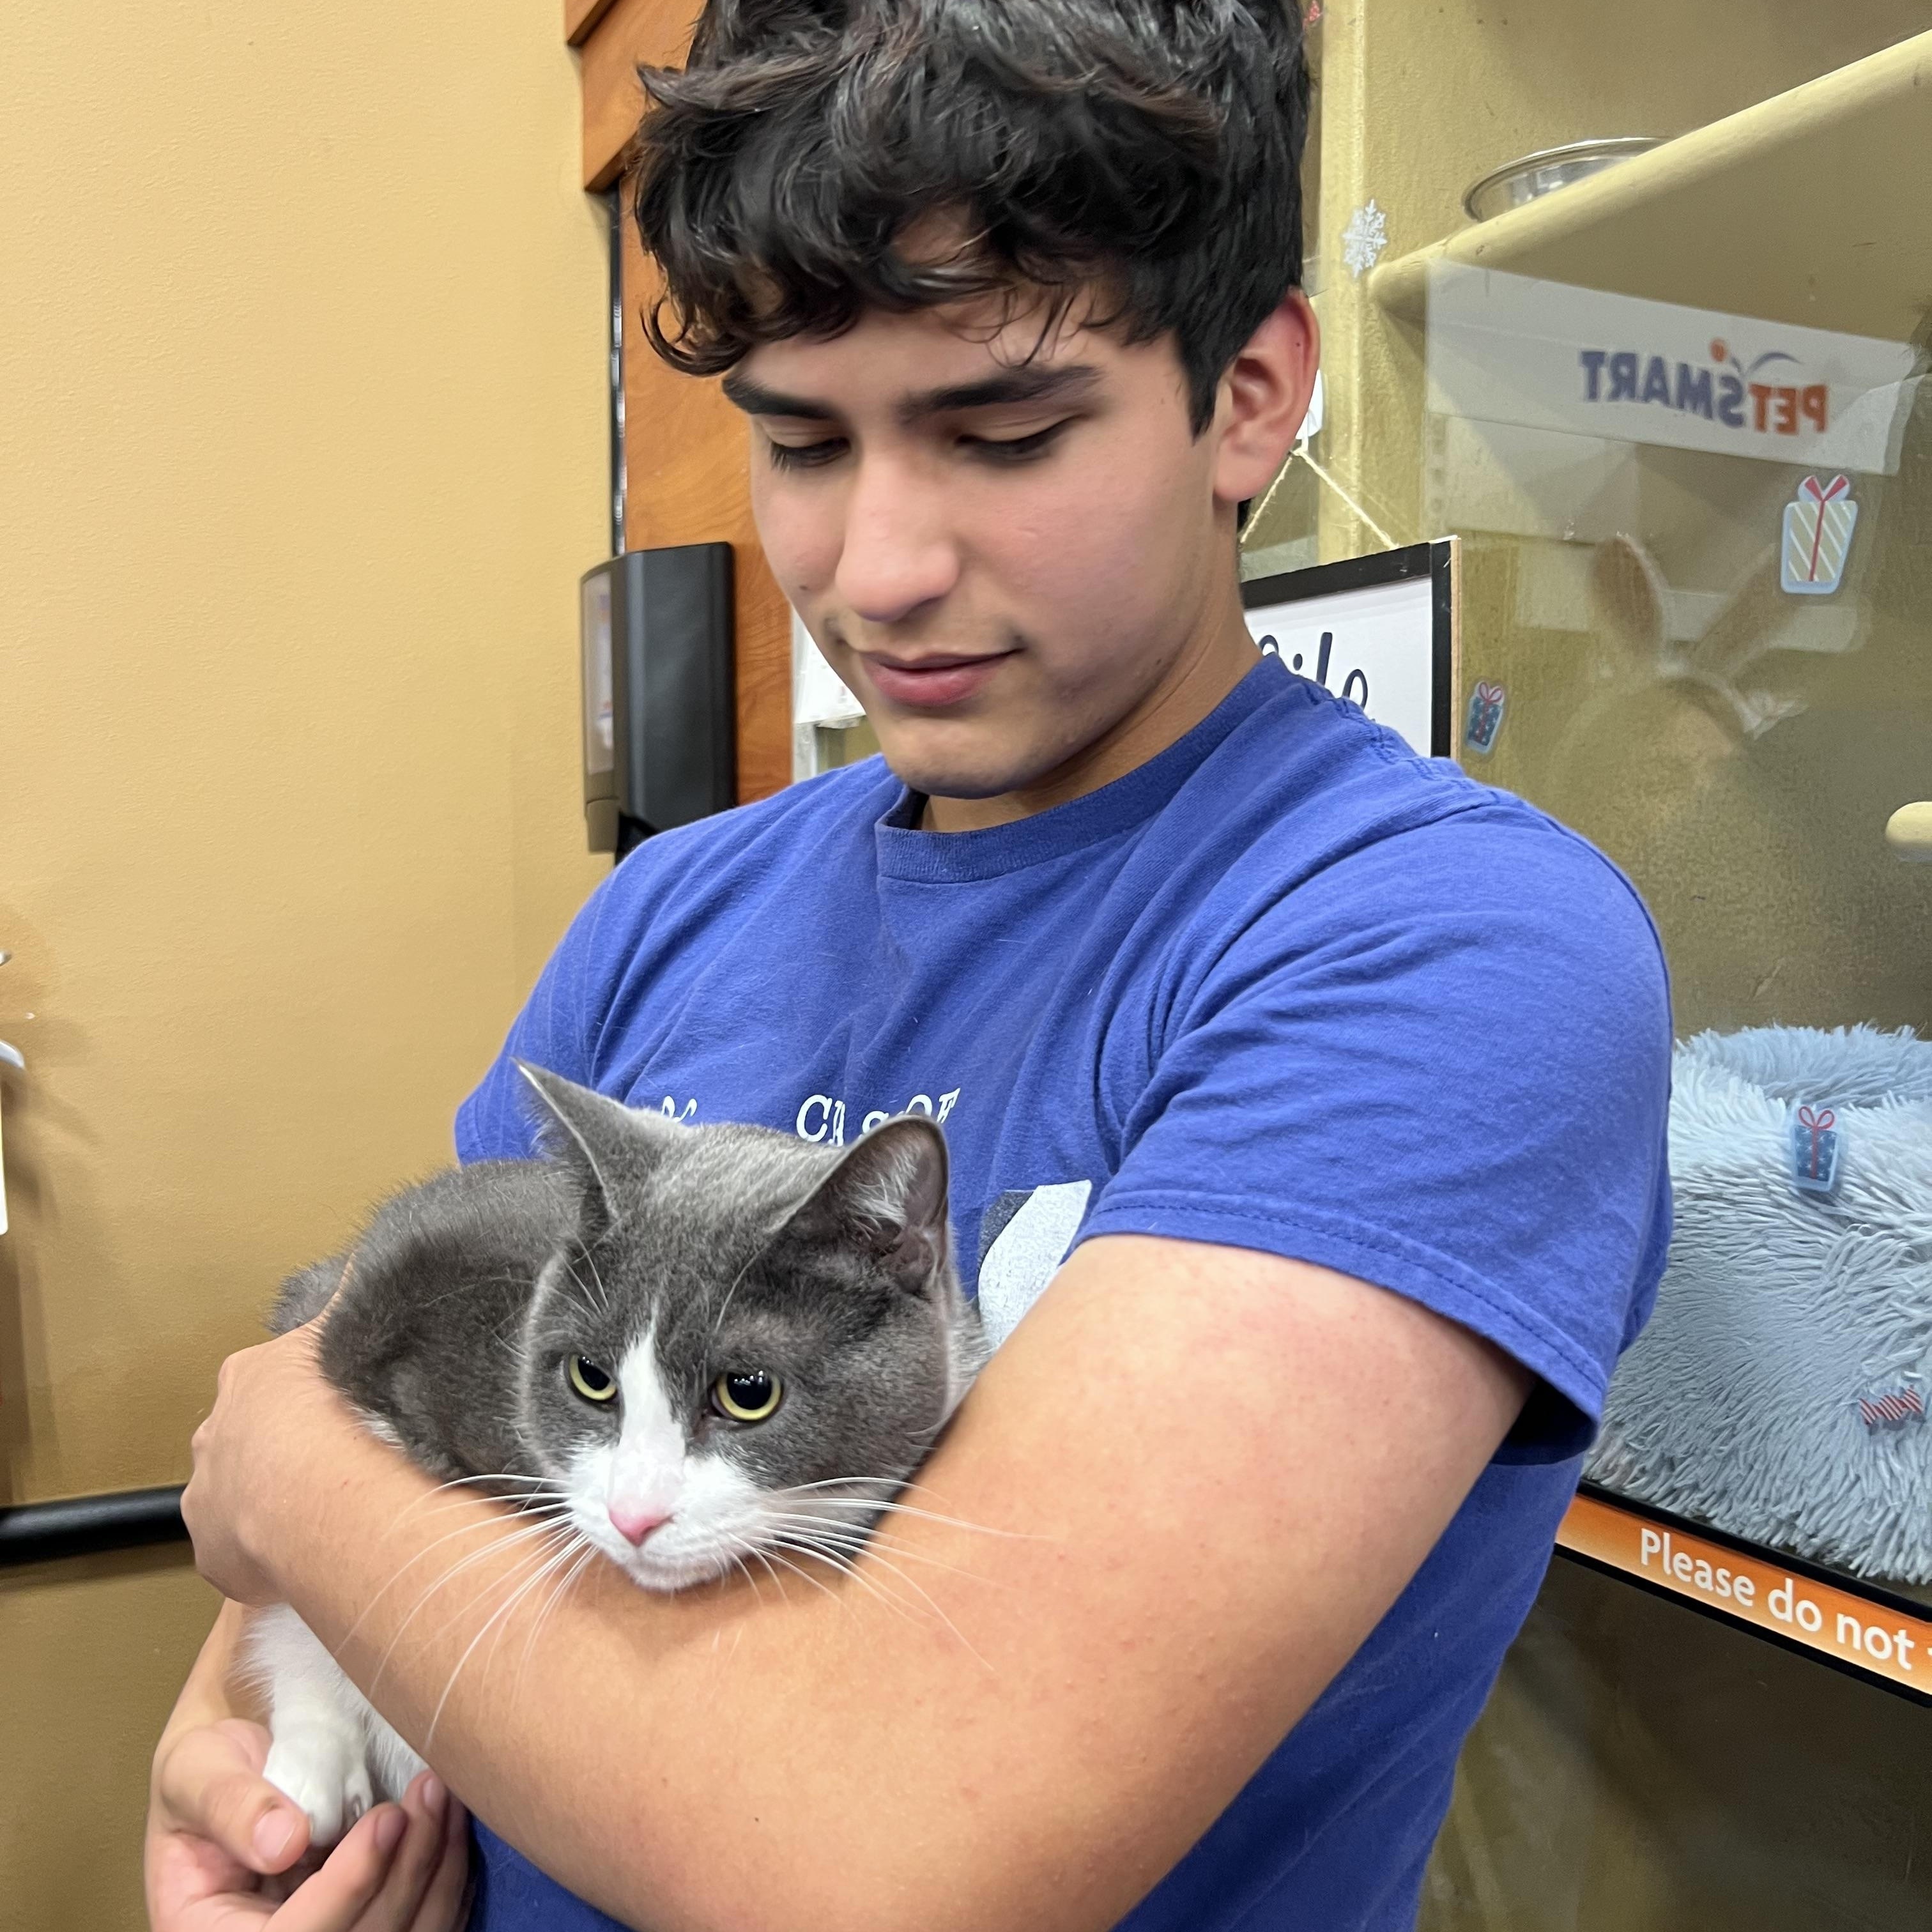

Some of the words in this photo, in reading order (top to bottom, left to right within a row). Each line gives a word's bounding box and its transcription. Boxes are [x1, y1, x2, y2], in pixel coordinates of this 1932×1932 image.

[1640, 1528, 1756, 1607] Please
[1768, 1578, 1823, 1632] do
[1836, 1612, 1915, 1670] not
